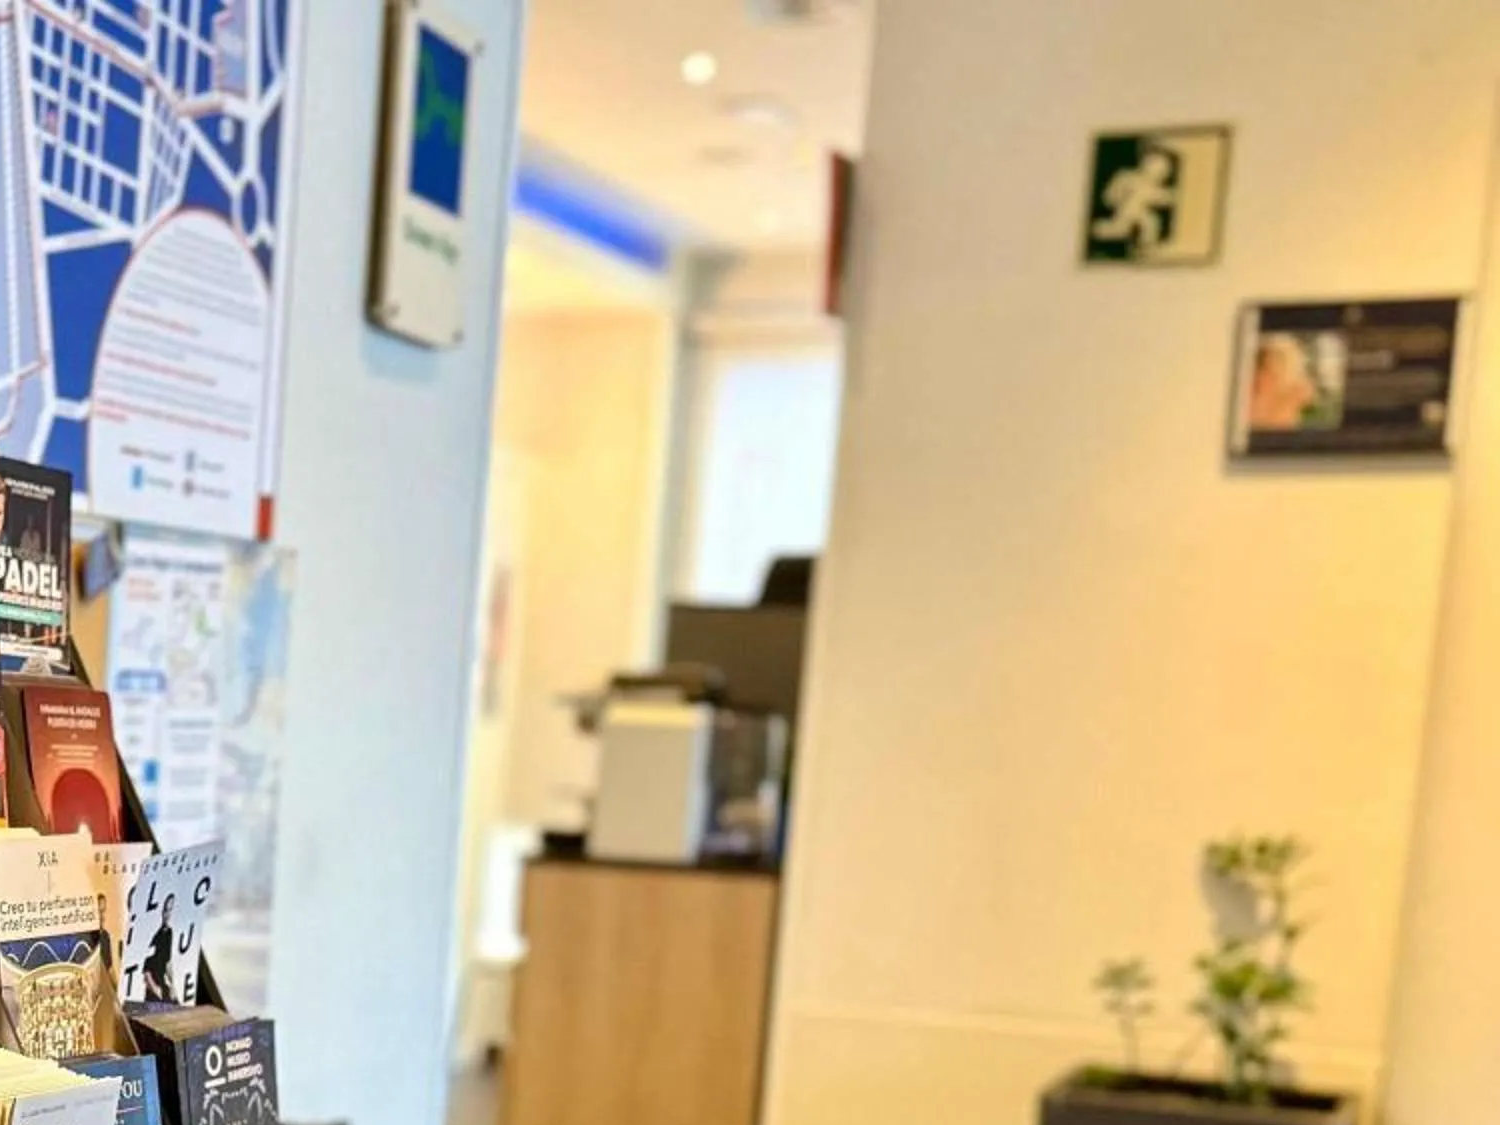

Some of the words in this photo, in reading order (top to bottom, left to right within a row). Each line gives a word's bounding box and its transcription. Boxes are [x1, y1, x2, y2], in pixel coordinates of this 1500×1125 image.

[0, 899, 25, 916] Crea
[27, 898, 37, 913] tu
[39, 895, 76, 914] perfume
[76, 895, 94, 907] con
